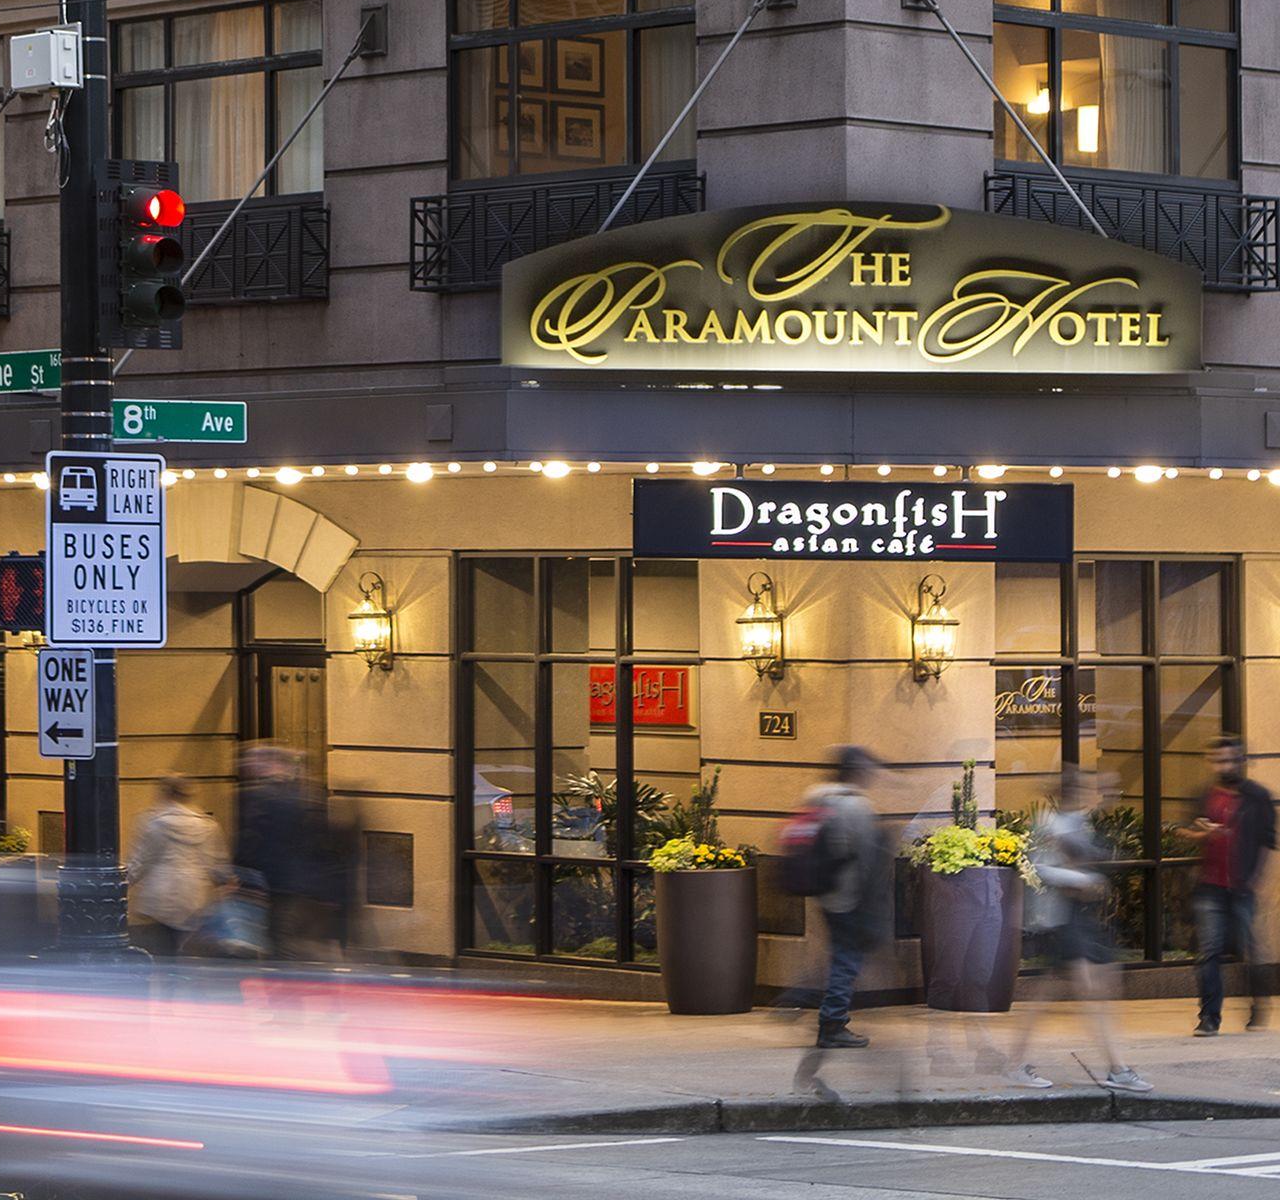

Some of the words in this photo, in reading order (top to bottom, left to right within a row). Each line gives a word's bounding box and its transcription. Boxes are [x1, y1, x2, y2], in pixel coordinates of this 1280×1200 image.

[31, 365, 45, 385] St
[123, 404, 157, 435] 8th
[201, 411, 234, 432] Ave
[111, 468, 156, 489] RIGHT
[114, 494, 154, 514] LANE
[64, 533, 151, 560] BUSES
[771, 534, 860, 554] asian
[74, 564, 141, 590] ONLY
[67, 599, 126, 614] BICYCLES
[133, 600, 148, 614] OK
[72, 618, 105, 634] $136
[112, 619, 145, 633] FINE
[44, 657, 87, 682] ONE
[44, 687, 89, 713] WAY
[763, 715, 791, 734] 724
